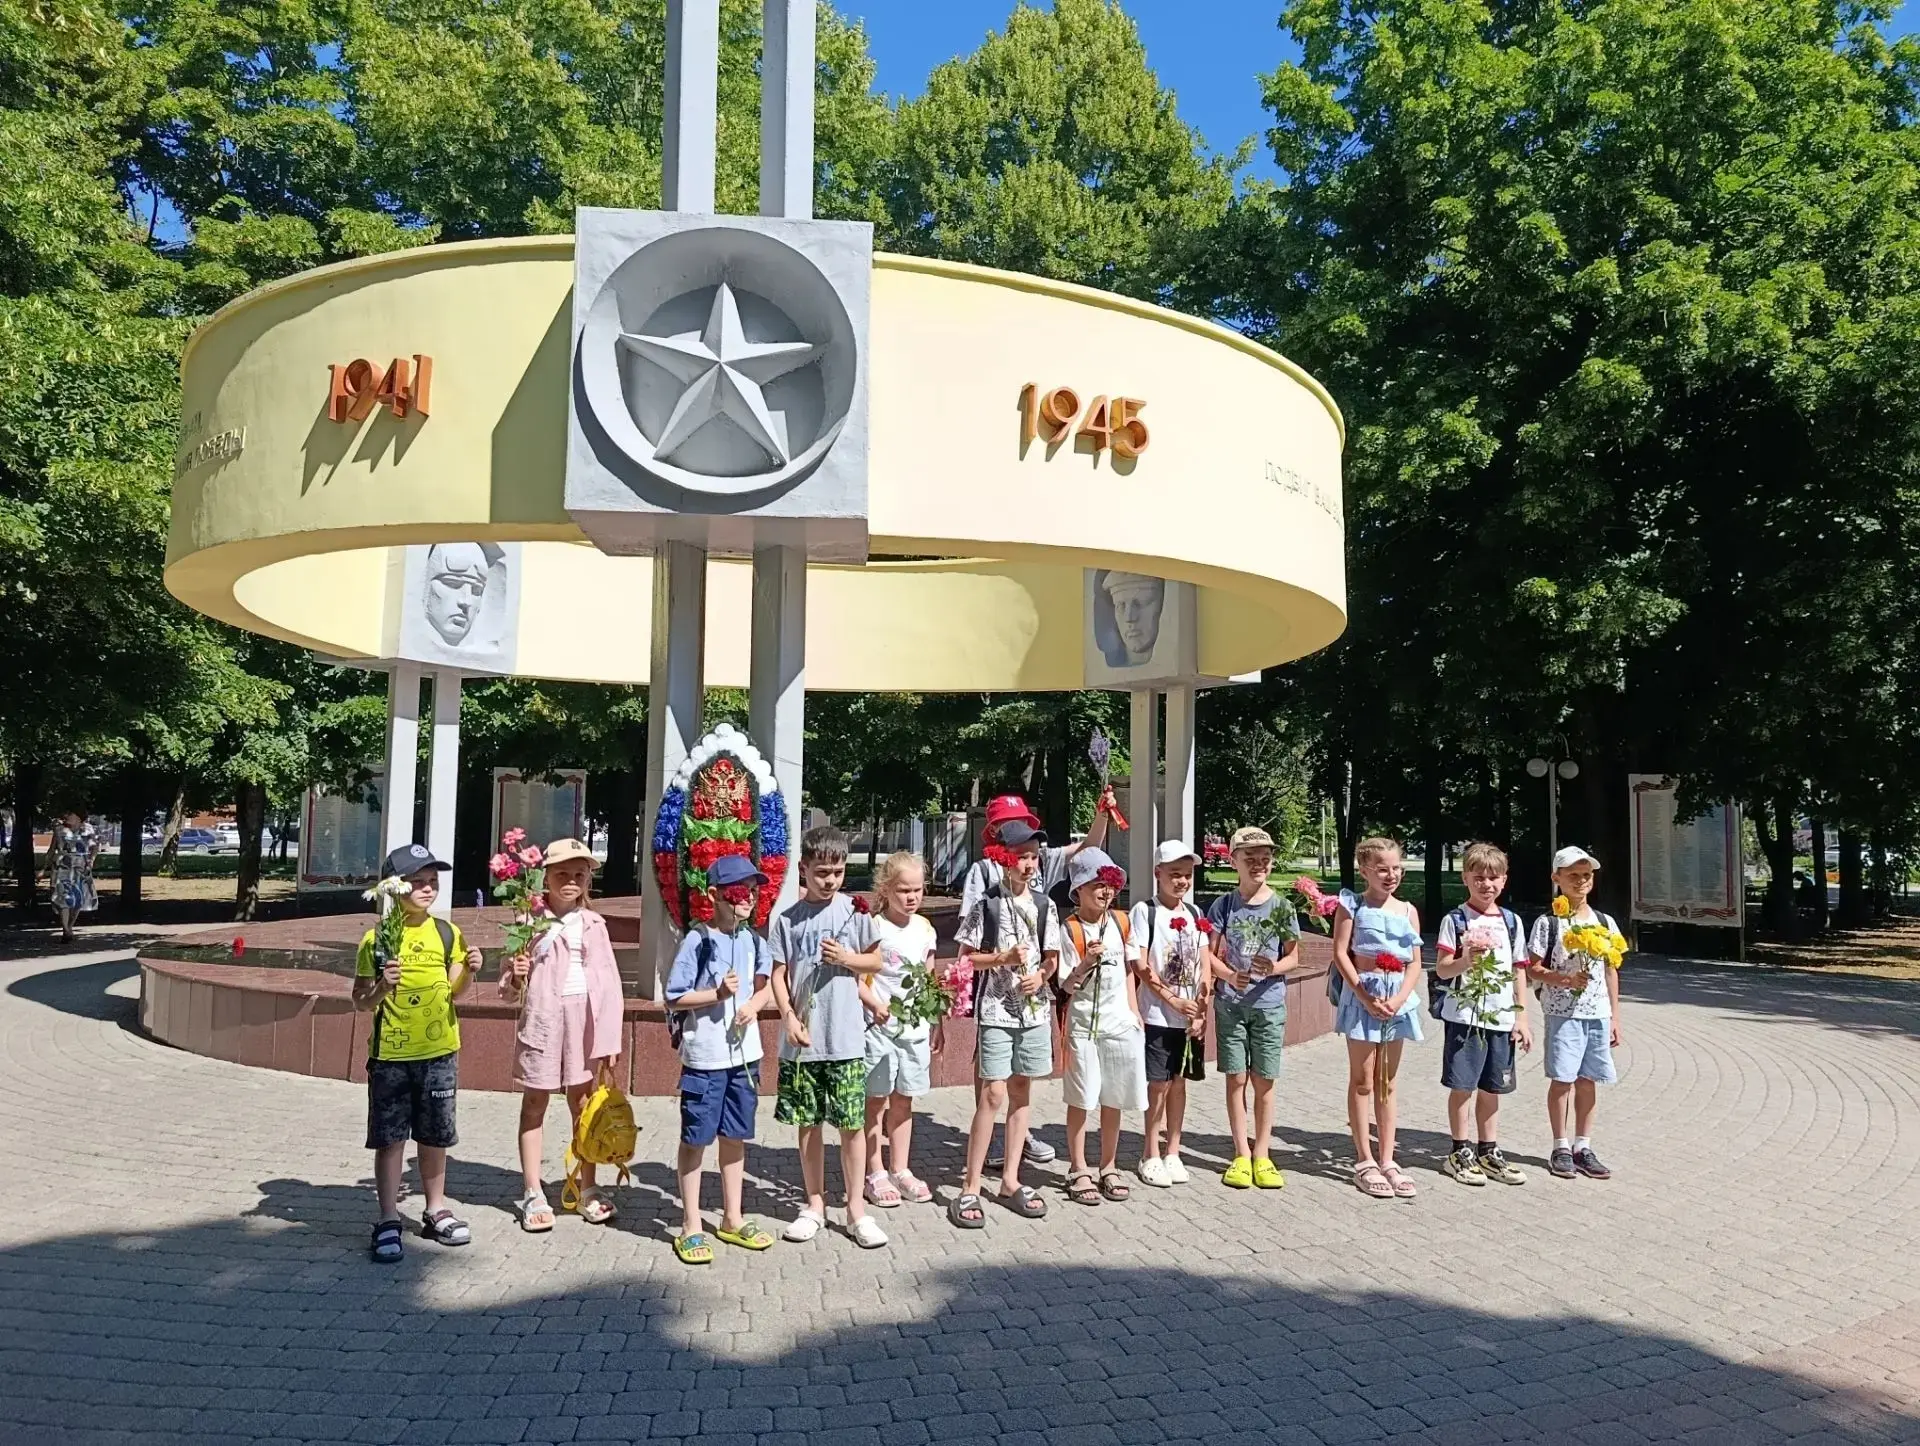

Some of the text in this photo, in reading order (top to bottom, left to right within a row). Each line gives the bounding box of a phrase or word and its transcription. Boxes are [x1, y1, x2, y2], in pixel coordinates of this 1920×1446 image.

[327, 354, 433, 424] 1941
[1017, 380, 1150, 460] 1945
[401, 952, 434, 966] XBOX
